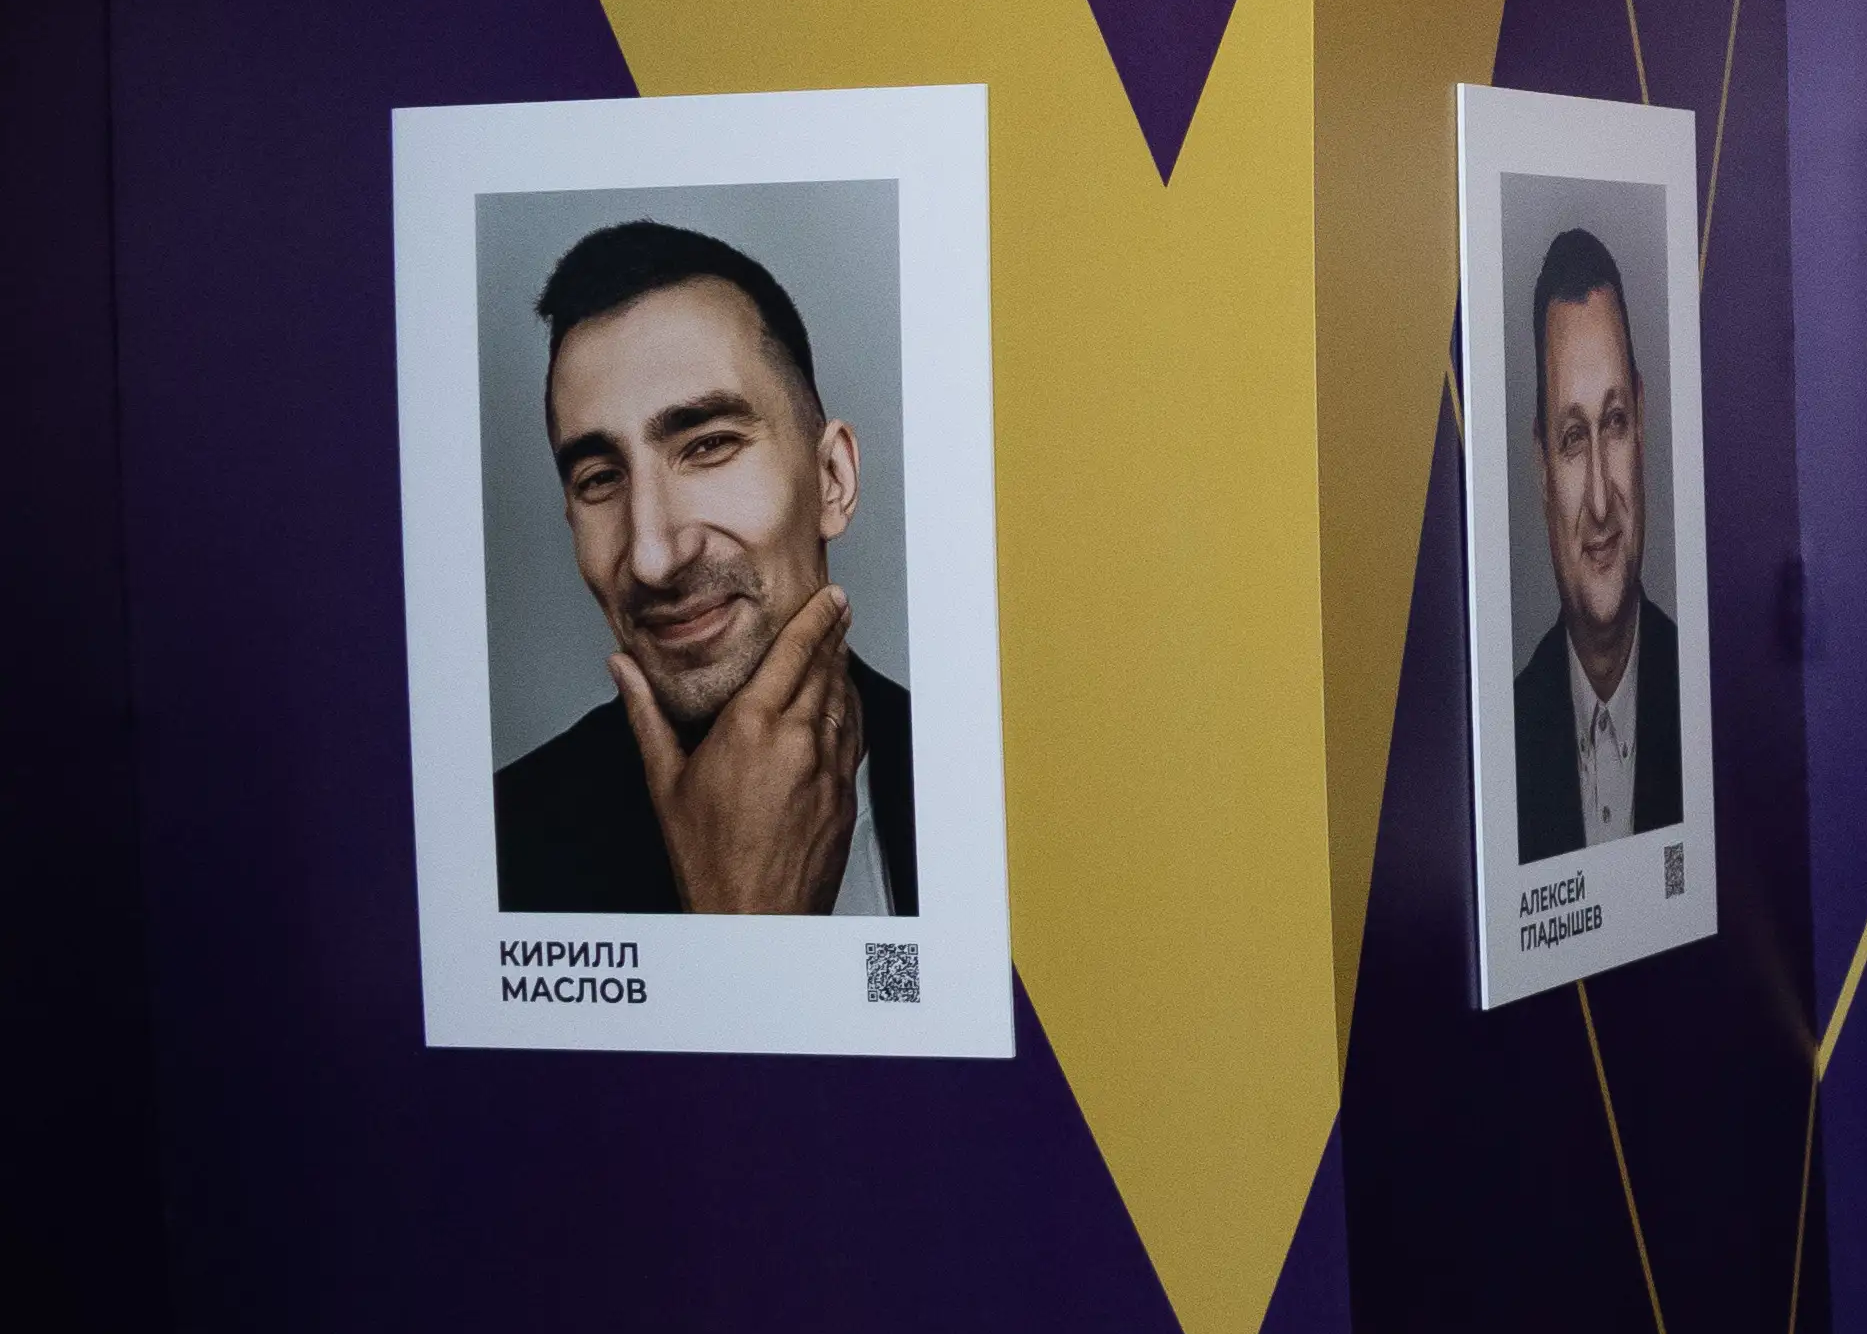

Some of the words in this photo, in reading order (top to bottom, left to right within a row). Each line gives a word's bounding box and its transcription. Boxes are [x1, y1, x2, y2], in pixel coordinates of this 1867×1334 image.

[1519, 869, 1586, 918] АЛЕКСЕЙ
[1520, 904, 1603, 952] ГЛАДЫШЕВ
[499, 940, 640, 969] КИРИЛЛ
[501, 975, 648, 1005] МАСЛОВ
